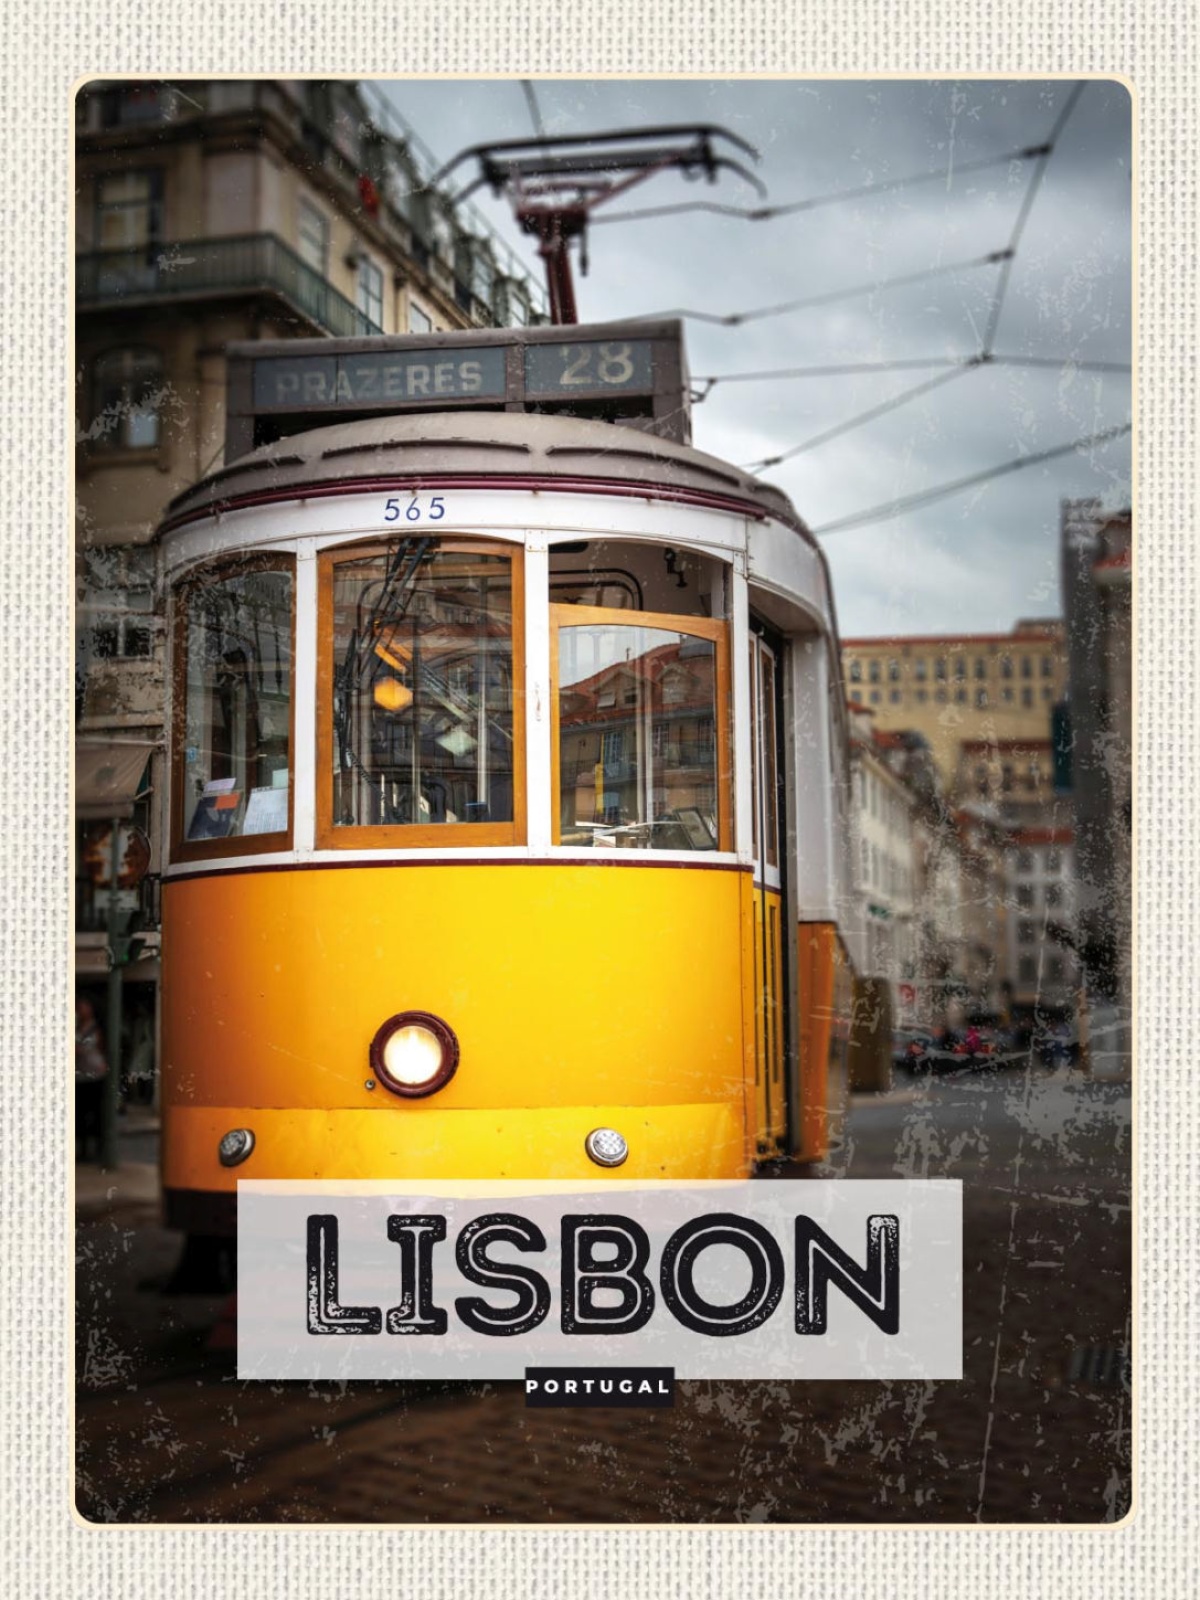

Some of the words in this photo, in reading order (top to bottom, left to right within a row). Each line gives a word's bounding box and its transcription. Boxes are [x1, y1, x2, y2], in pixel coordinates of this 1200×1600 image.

[275, 360, 482, 402] PRAZERES
[559, 342, 635, 385] 28
[384, 497, 445, 521] 565
